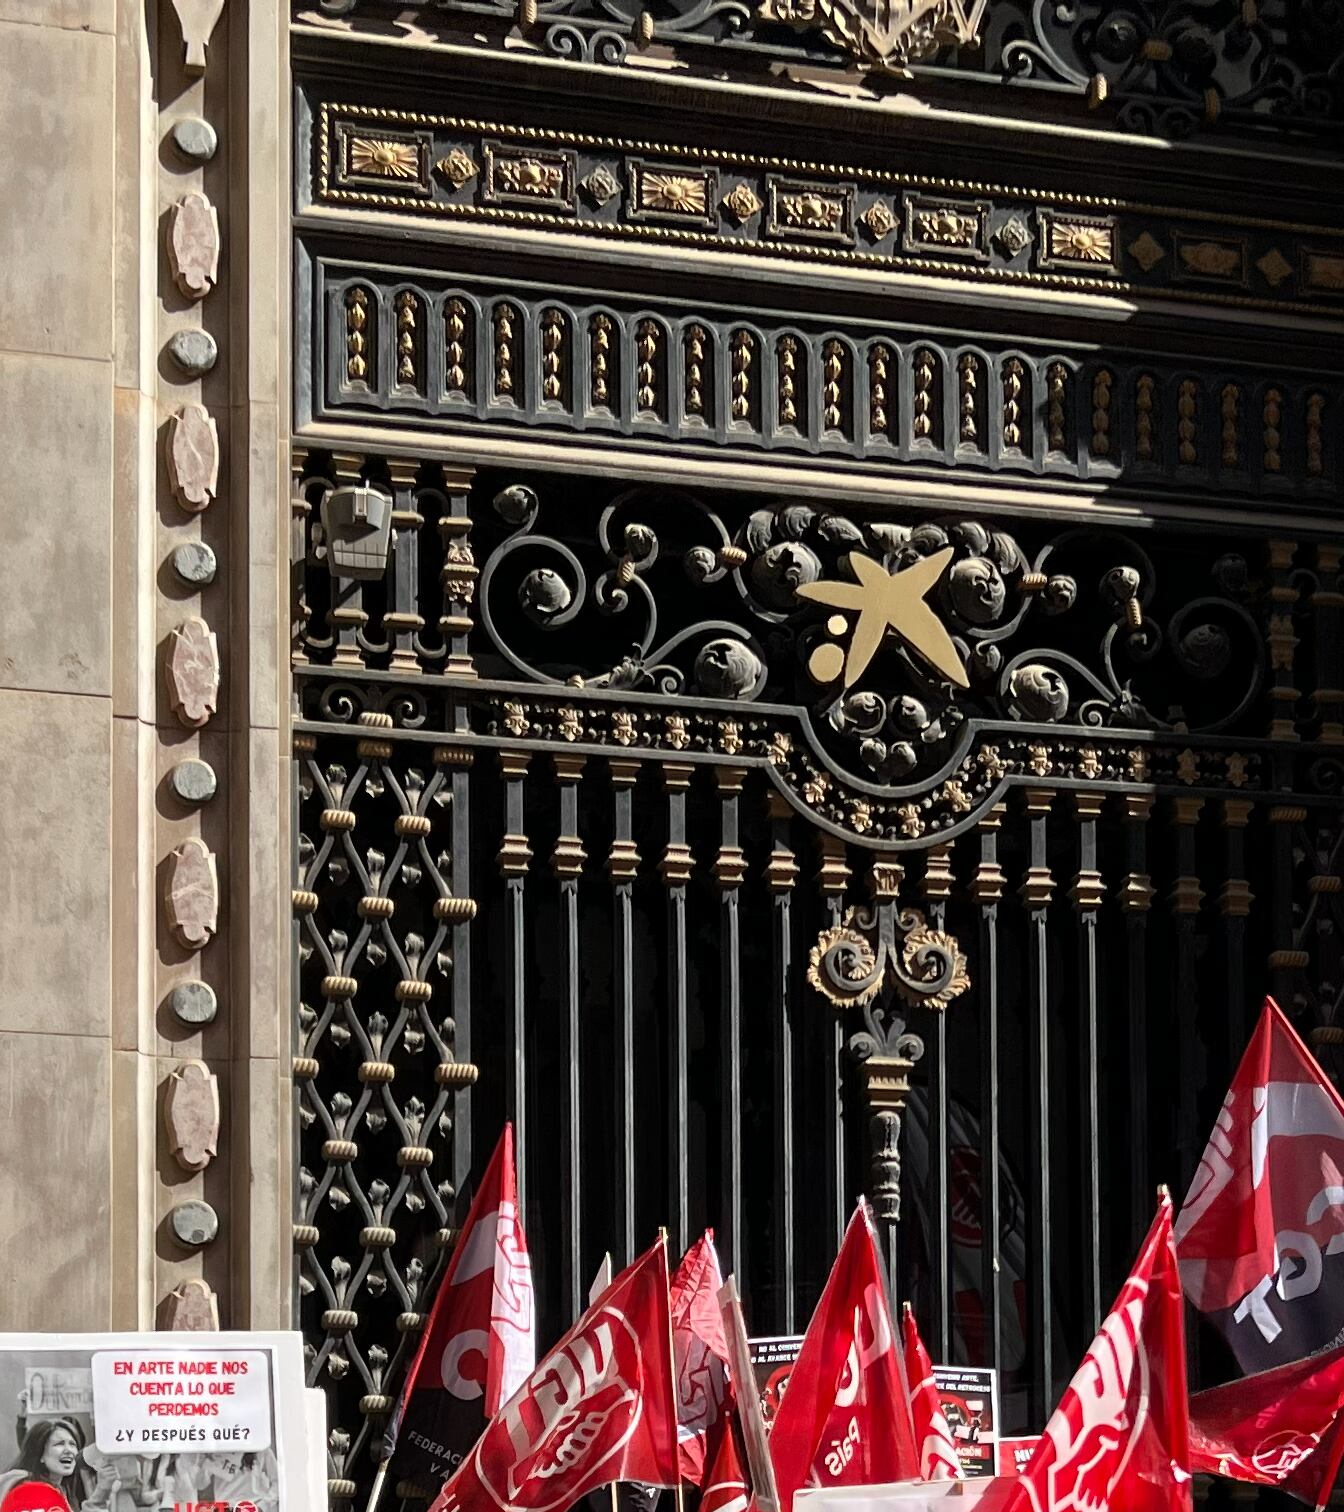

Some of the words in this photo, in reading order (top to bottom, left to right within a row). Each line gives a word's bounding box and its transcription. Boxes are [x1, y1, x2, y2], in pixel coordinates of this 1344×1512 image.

[114, 1361, 133, 1375] EN
[138, 1361, 174, 1375] ARTE
[178, 1361, 218, 1375] NADIE
[221, 1361, 248, 1375] NOS
[129, 1382, 184, 1396] CUENTA
[188, 1382, 204, 1396] LO
[208, 1382, 235, 1396] QUE
[148, 1402, 219, 1416] PERDEMOS
[115, 1429, 134, 1442] ¿Y
[142, 1424, 206, 1442] DESPUÉS
[213, 1424, 251, 1441] QUÉ?
